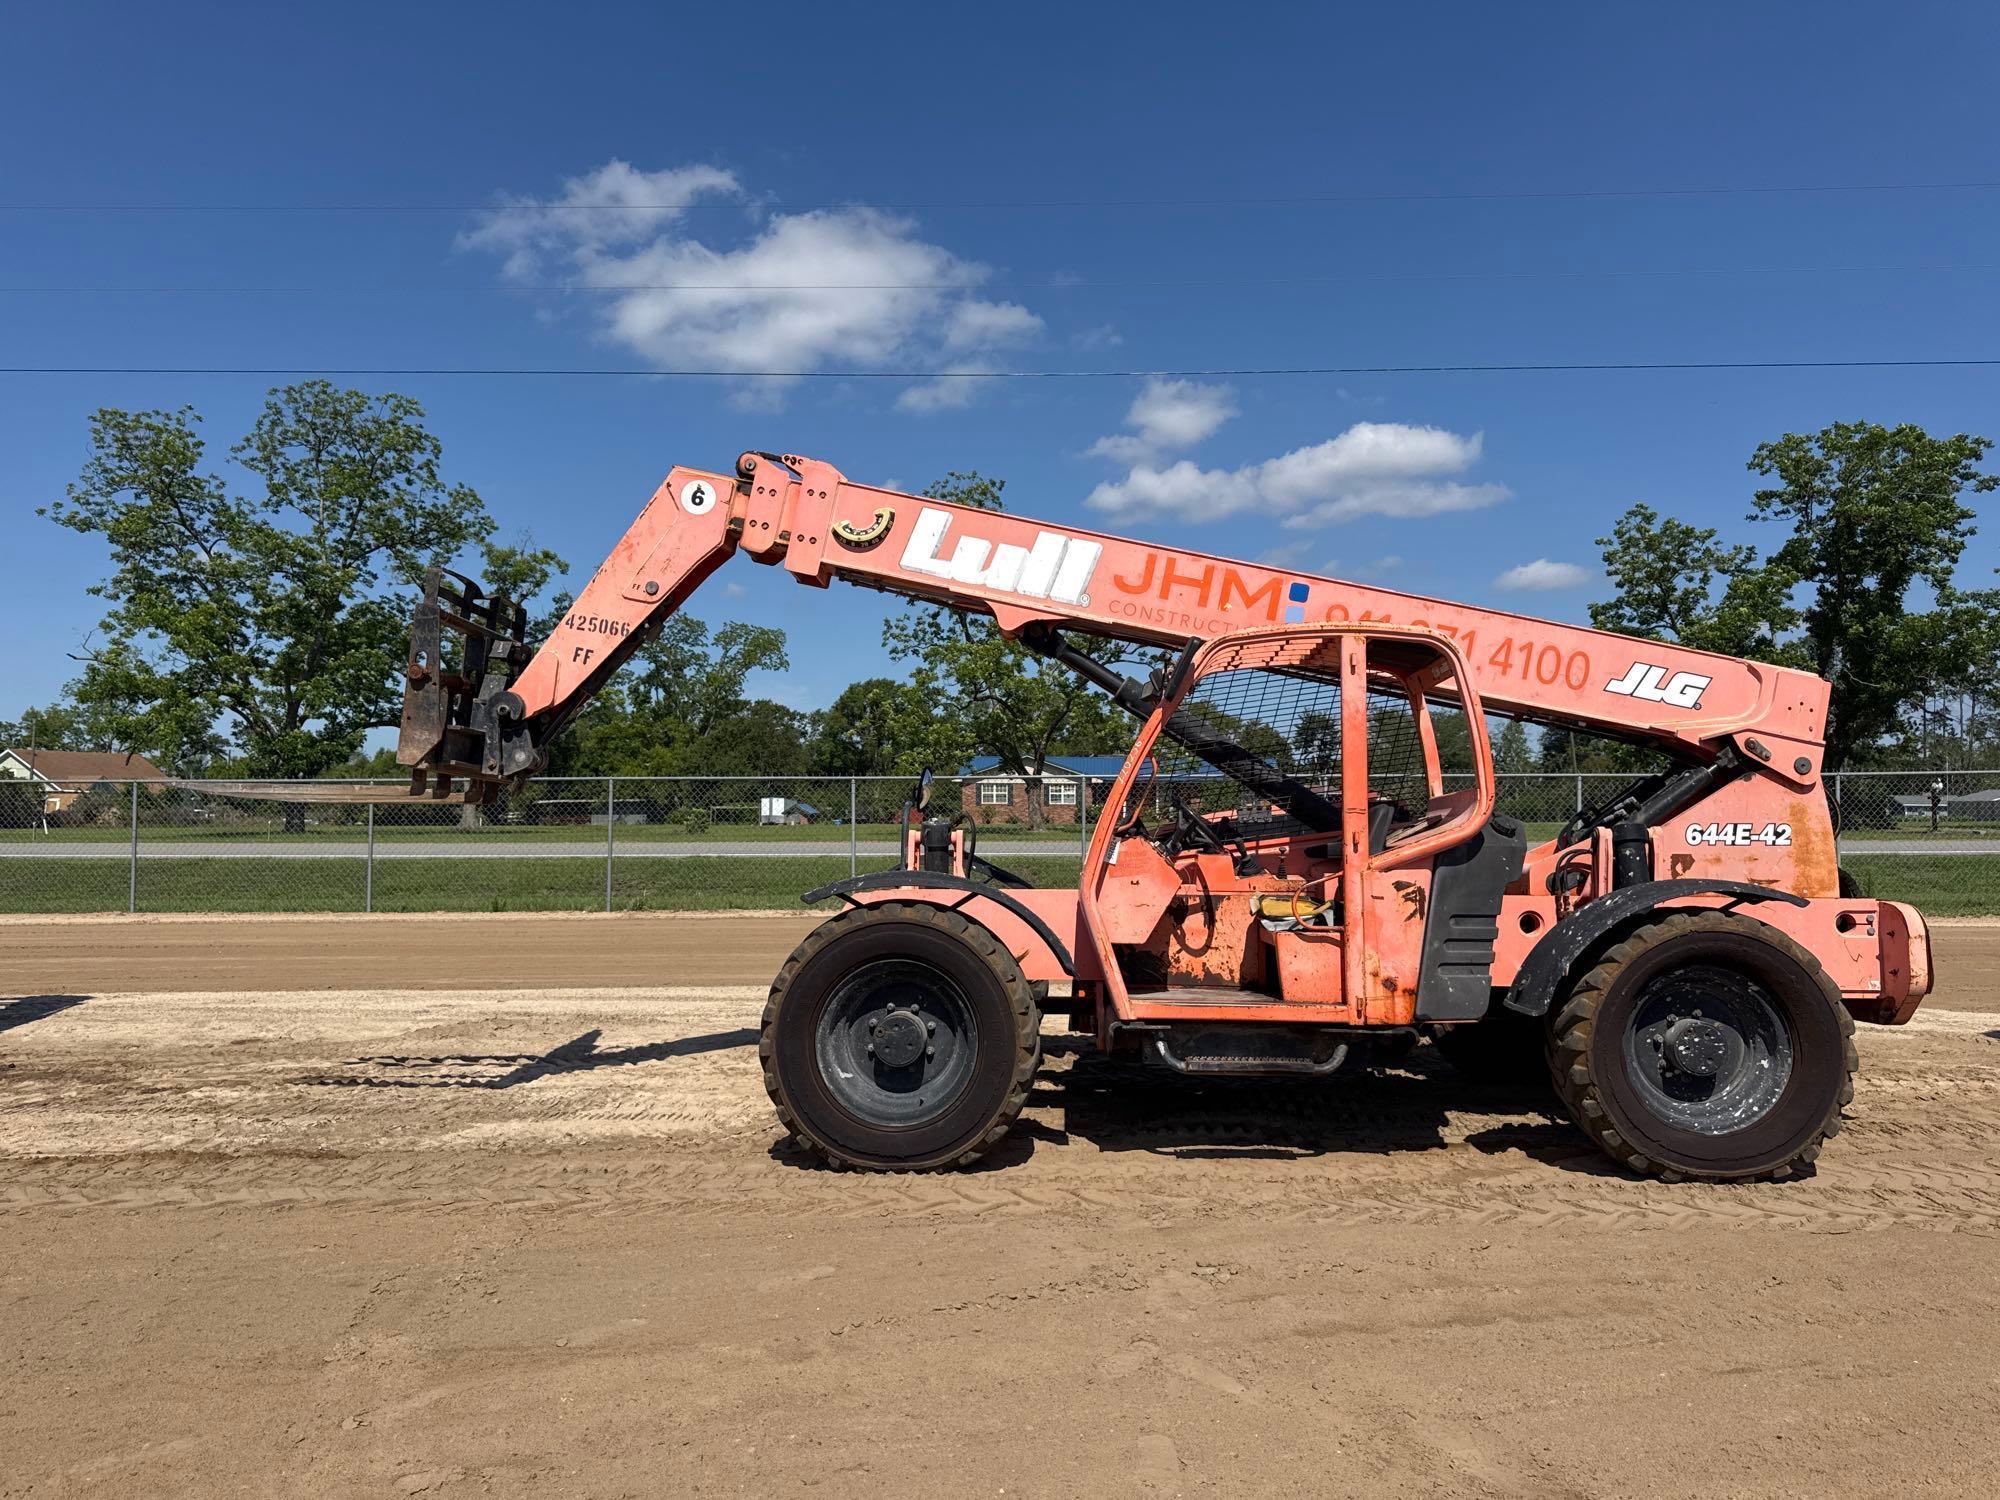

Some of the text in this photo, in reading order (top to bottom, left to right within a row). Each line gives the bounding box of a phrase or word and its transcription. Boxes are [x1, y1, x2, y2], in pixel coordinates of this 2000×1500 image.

[691, 487, 705, 506] 6
[899, 507, 1104, 606] Lull
[1113, 553, 1284, 622] JHM
[565, 613, 631, 637] 425066
[1108, 600, 1241, 635] CONSTRUCTI
[573, 647, 595, 666] FF
[1603, 661, 1713, 710] JLG
[1685, 823, 1792, 846] 644E-42
